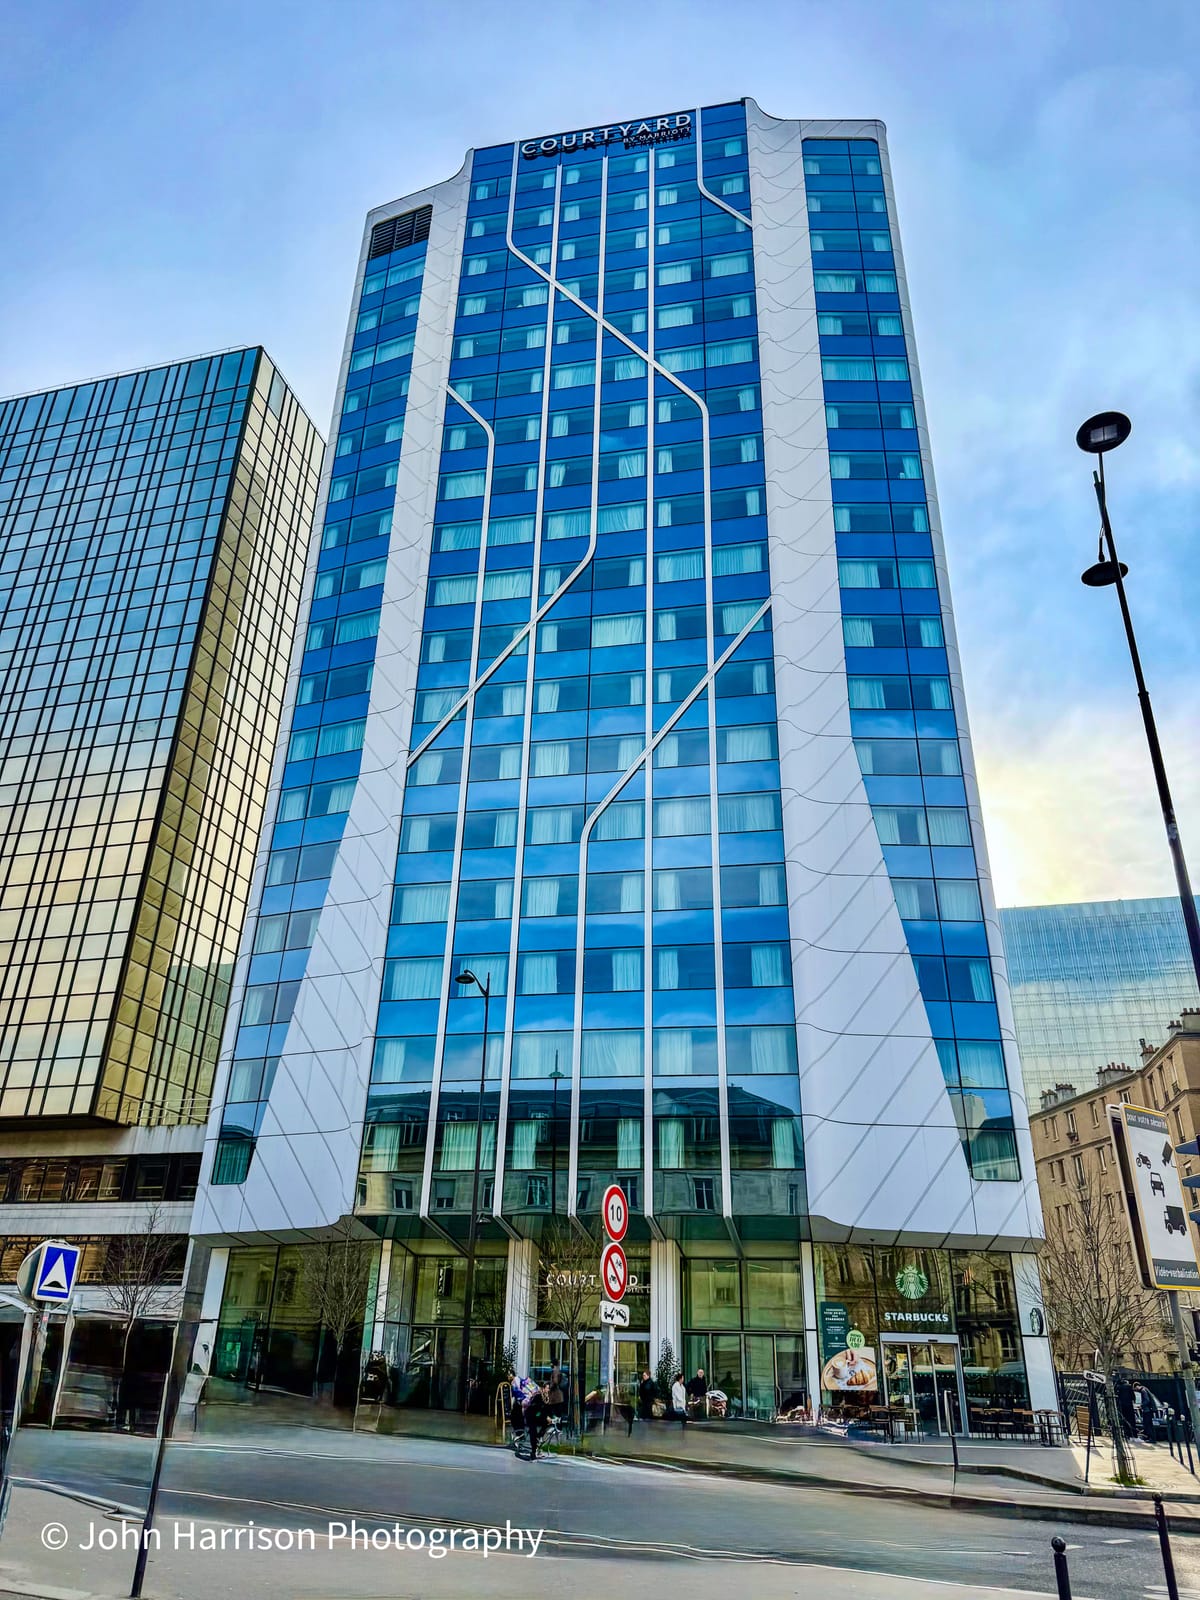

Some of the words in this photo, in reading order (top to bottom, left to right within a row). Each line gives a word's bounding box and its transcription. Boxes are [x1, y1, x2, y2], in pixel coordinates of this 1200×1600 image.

[521, 114, 691, 154] COURTYARD
[640, 126, 691, 141] MARRIOTT
[610, 1204, 622, 1221] 10
[546, 1274, 638, 1286] COURTD
[884, 1311, 949, 1322] STARBUCKS
